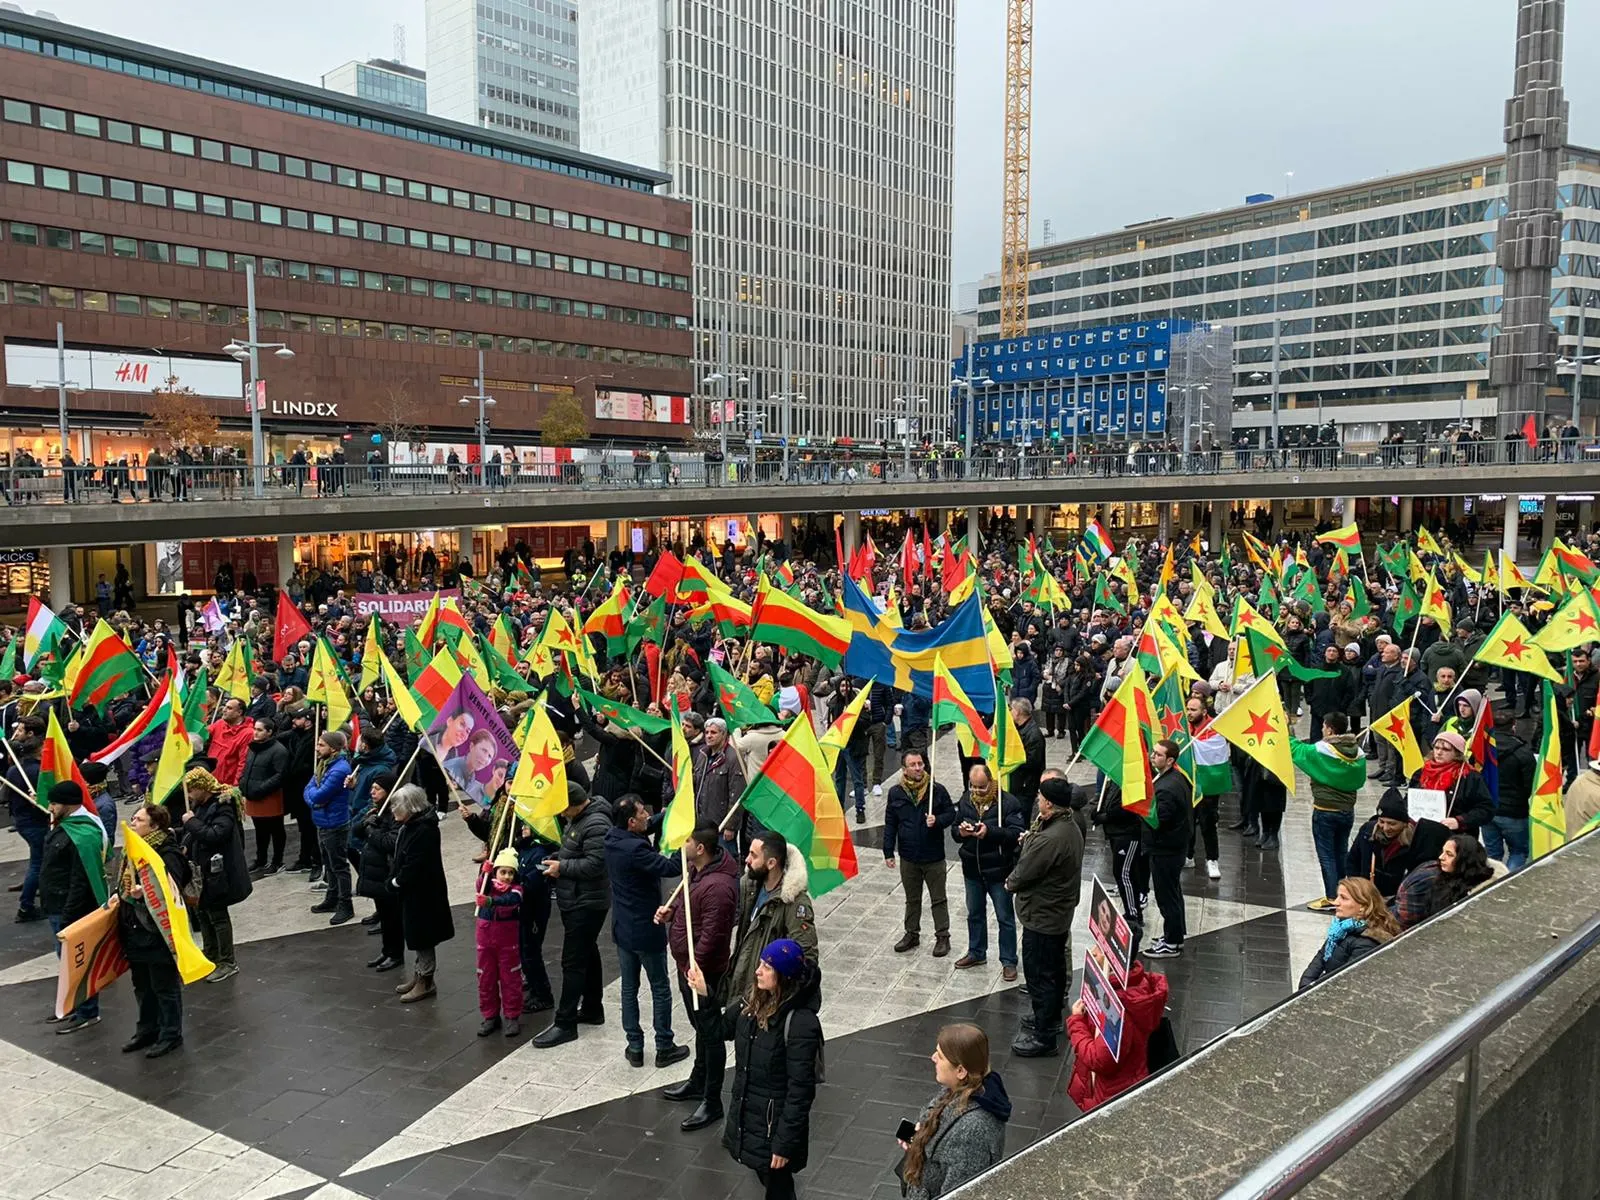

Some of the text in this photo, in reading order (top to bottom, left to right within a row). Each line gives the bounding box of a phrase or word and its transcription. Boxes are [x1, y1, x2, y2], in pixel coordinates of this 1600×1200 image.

[115, 362, 148, 384] H&M
[272, 400, 338, 417] LINDEX
[0, 552, 35, 562] KICKS
[358, 597, 458, 615] SOLIDARIE
